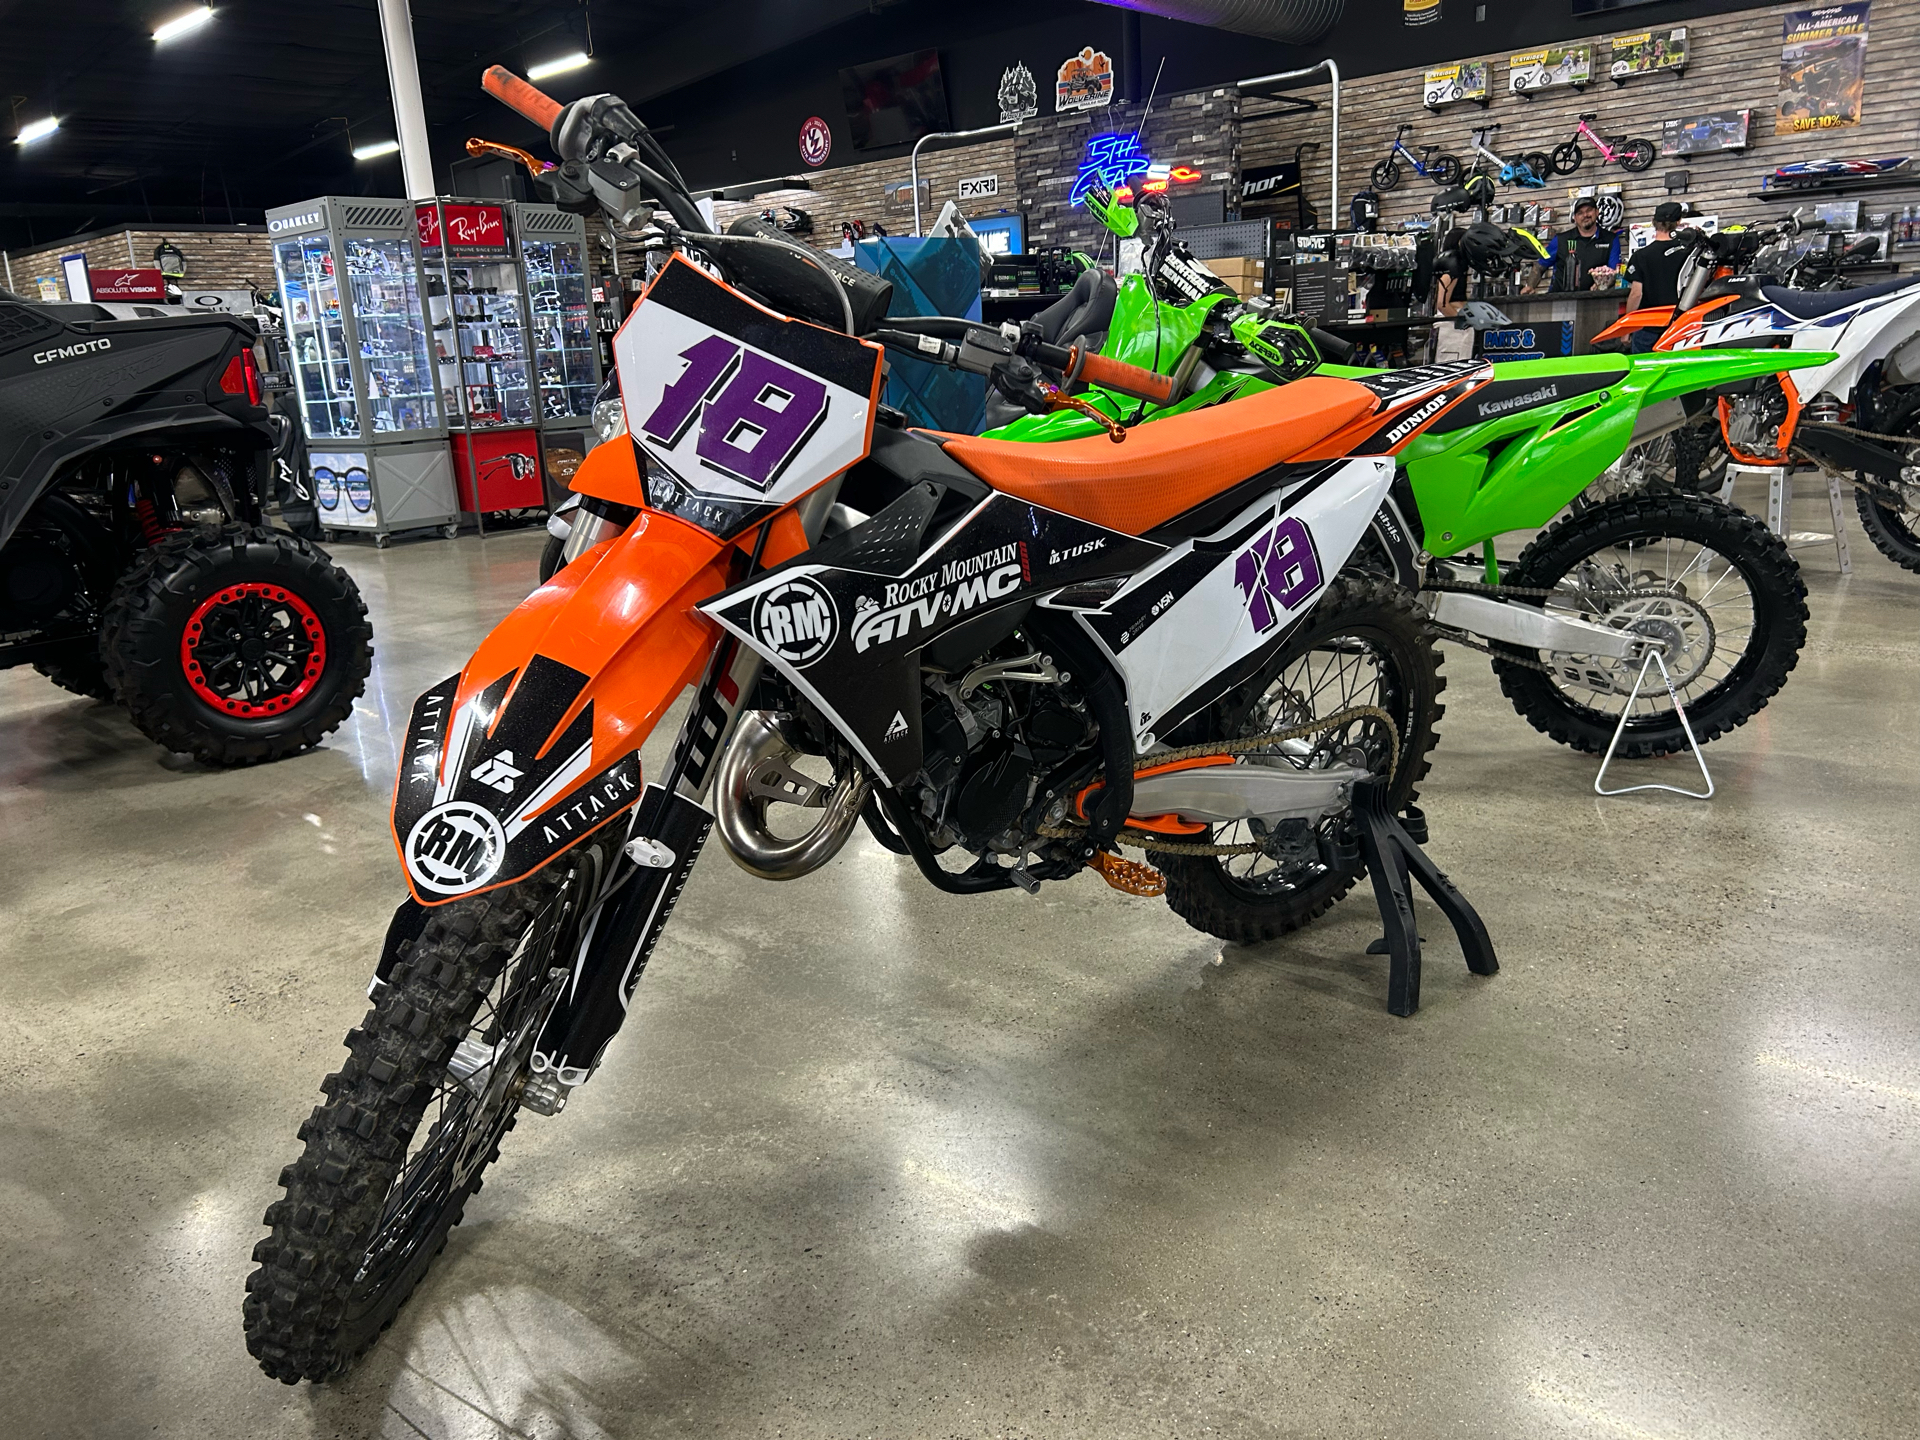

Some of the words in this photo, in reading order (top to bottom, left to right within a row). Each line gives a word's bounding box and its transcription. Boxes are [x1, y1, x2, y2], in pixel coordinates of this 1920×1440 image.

[1786, 28, 1832, 44] SUMMER
[1836, 23, 1866, 36] SALE
[1796, 14, 1859, 32] ALL-AMERICAN
[1519, 53, 1545, 62] STRIDER
[1431, 68, 1456, 77] STRIDER
[1059, 90, 1110, 107] WOLVERINE
[1001, 110, 1036, 121] WOLVERINE
[1793, 118, 1817, 131] SAVE
[1819, 115, 1841, 128] 10%
[1079, 134, 1140, 170] 5TH
[961, 180, 990, 196] FXR
[1241, 174, 1283, 197] hor
[33, 338, 111, 364] CFMOTO
[1483, 329, 1521, 349] PARTS
[1521, 328, 1536, 349] &
[1478, 384, 1558, 416] Kawasaki
[641, 334, 831, 494] 18
[1386, 393, 1448, 444] DUNLOP
[662, 487, 723, 522] ATTACK
[1063, 537, 1106, 561] TUSK
[884, 571, 937, 610] ROCKY
[939, 541, 1018, 588] MOUNTAIN
[1234, 516, 1324, 635] 18
[1157, 591, 1175, 609] VSN
[769, 604, 823, 646] RM
[884, 729, 908, 743] ATTACK
[1405, 711, 1414, 738] EXCEL
[410, 694, 444, 785] ATTACK
[543, 772, 635, 844] ATTACK
[421, 820, 483, 875] RM
[630, 924, 665, 990] ATTACK
[664, 822, 712, 917] GRAPHICS
